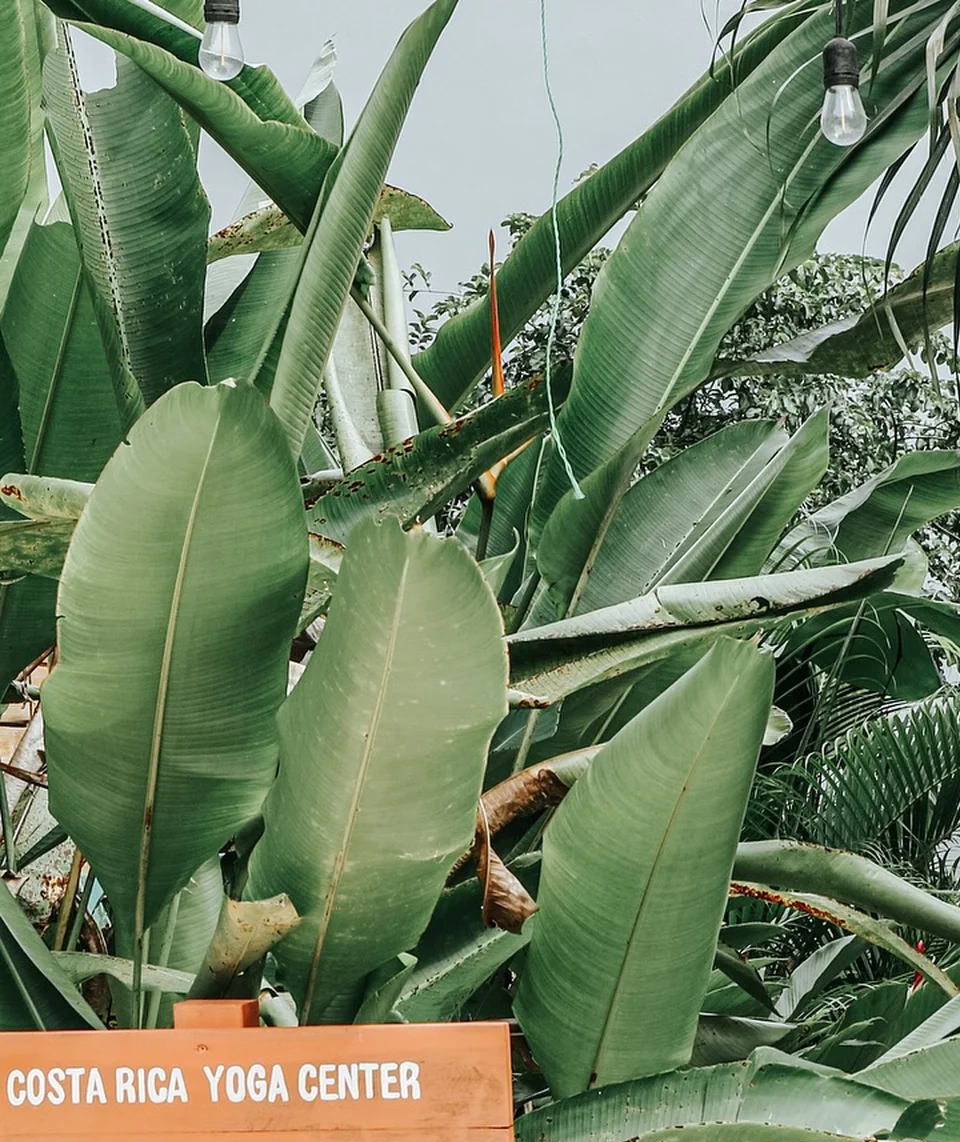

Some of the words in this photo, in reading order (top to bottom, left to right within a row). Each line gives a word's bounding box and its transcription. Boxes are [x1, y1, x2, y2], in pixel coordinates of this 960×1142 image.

[7, 1067, 108, 1106] COSTA
[115, 1067, 189, 1104] RICA
[203, 1064, 289, 1103] YOGA
[299, 1061, 421, 1101] CENTER
